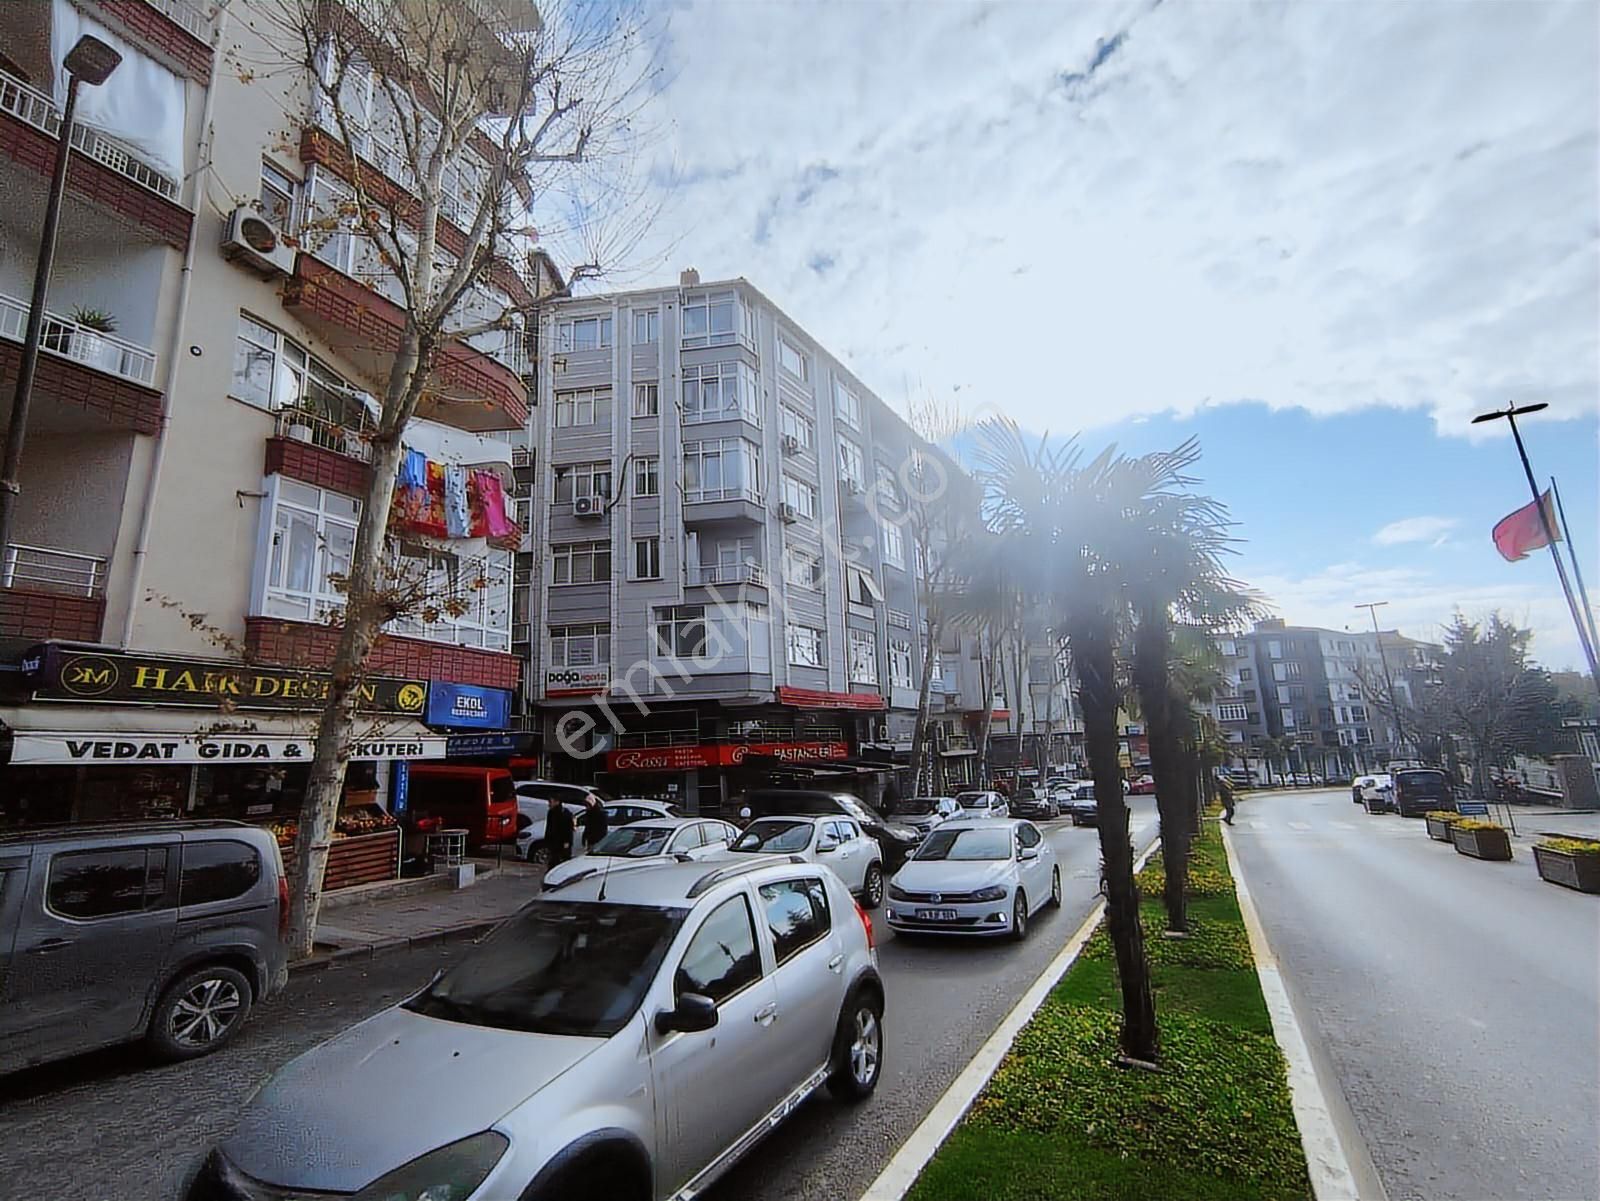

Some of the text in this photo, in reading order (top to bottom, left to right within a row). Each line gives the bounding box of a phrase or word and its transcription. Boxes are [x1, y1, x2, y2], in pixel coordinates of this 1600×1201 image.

[252, 676, 379, 701] DESIN
[457, 696, 483, 710] EKOL
[66, 741, 178, 759] VEDAT
[198, 743, 271, 759] GIDA
[282, 743, 302, 758] &
